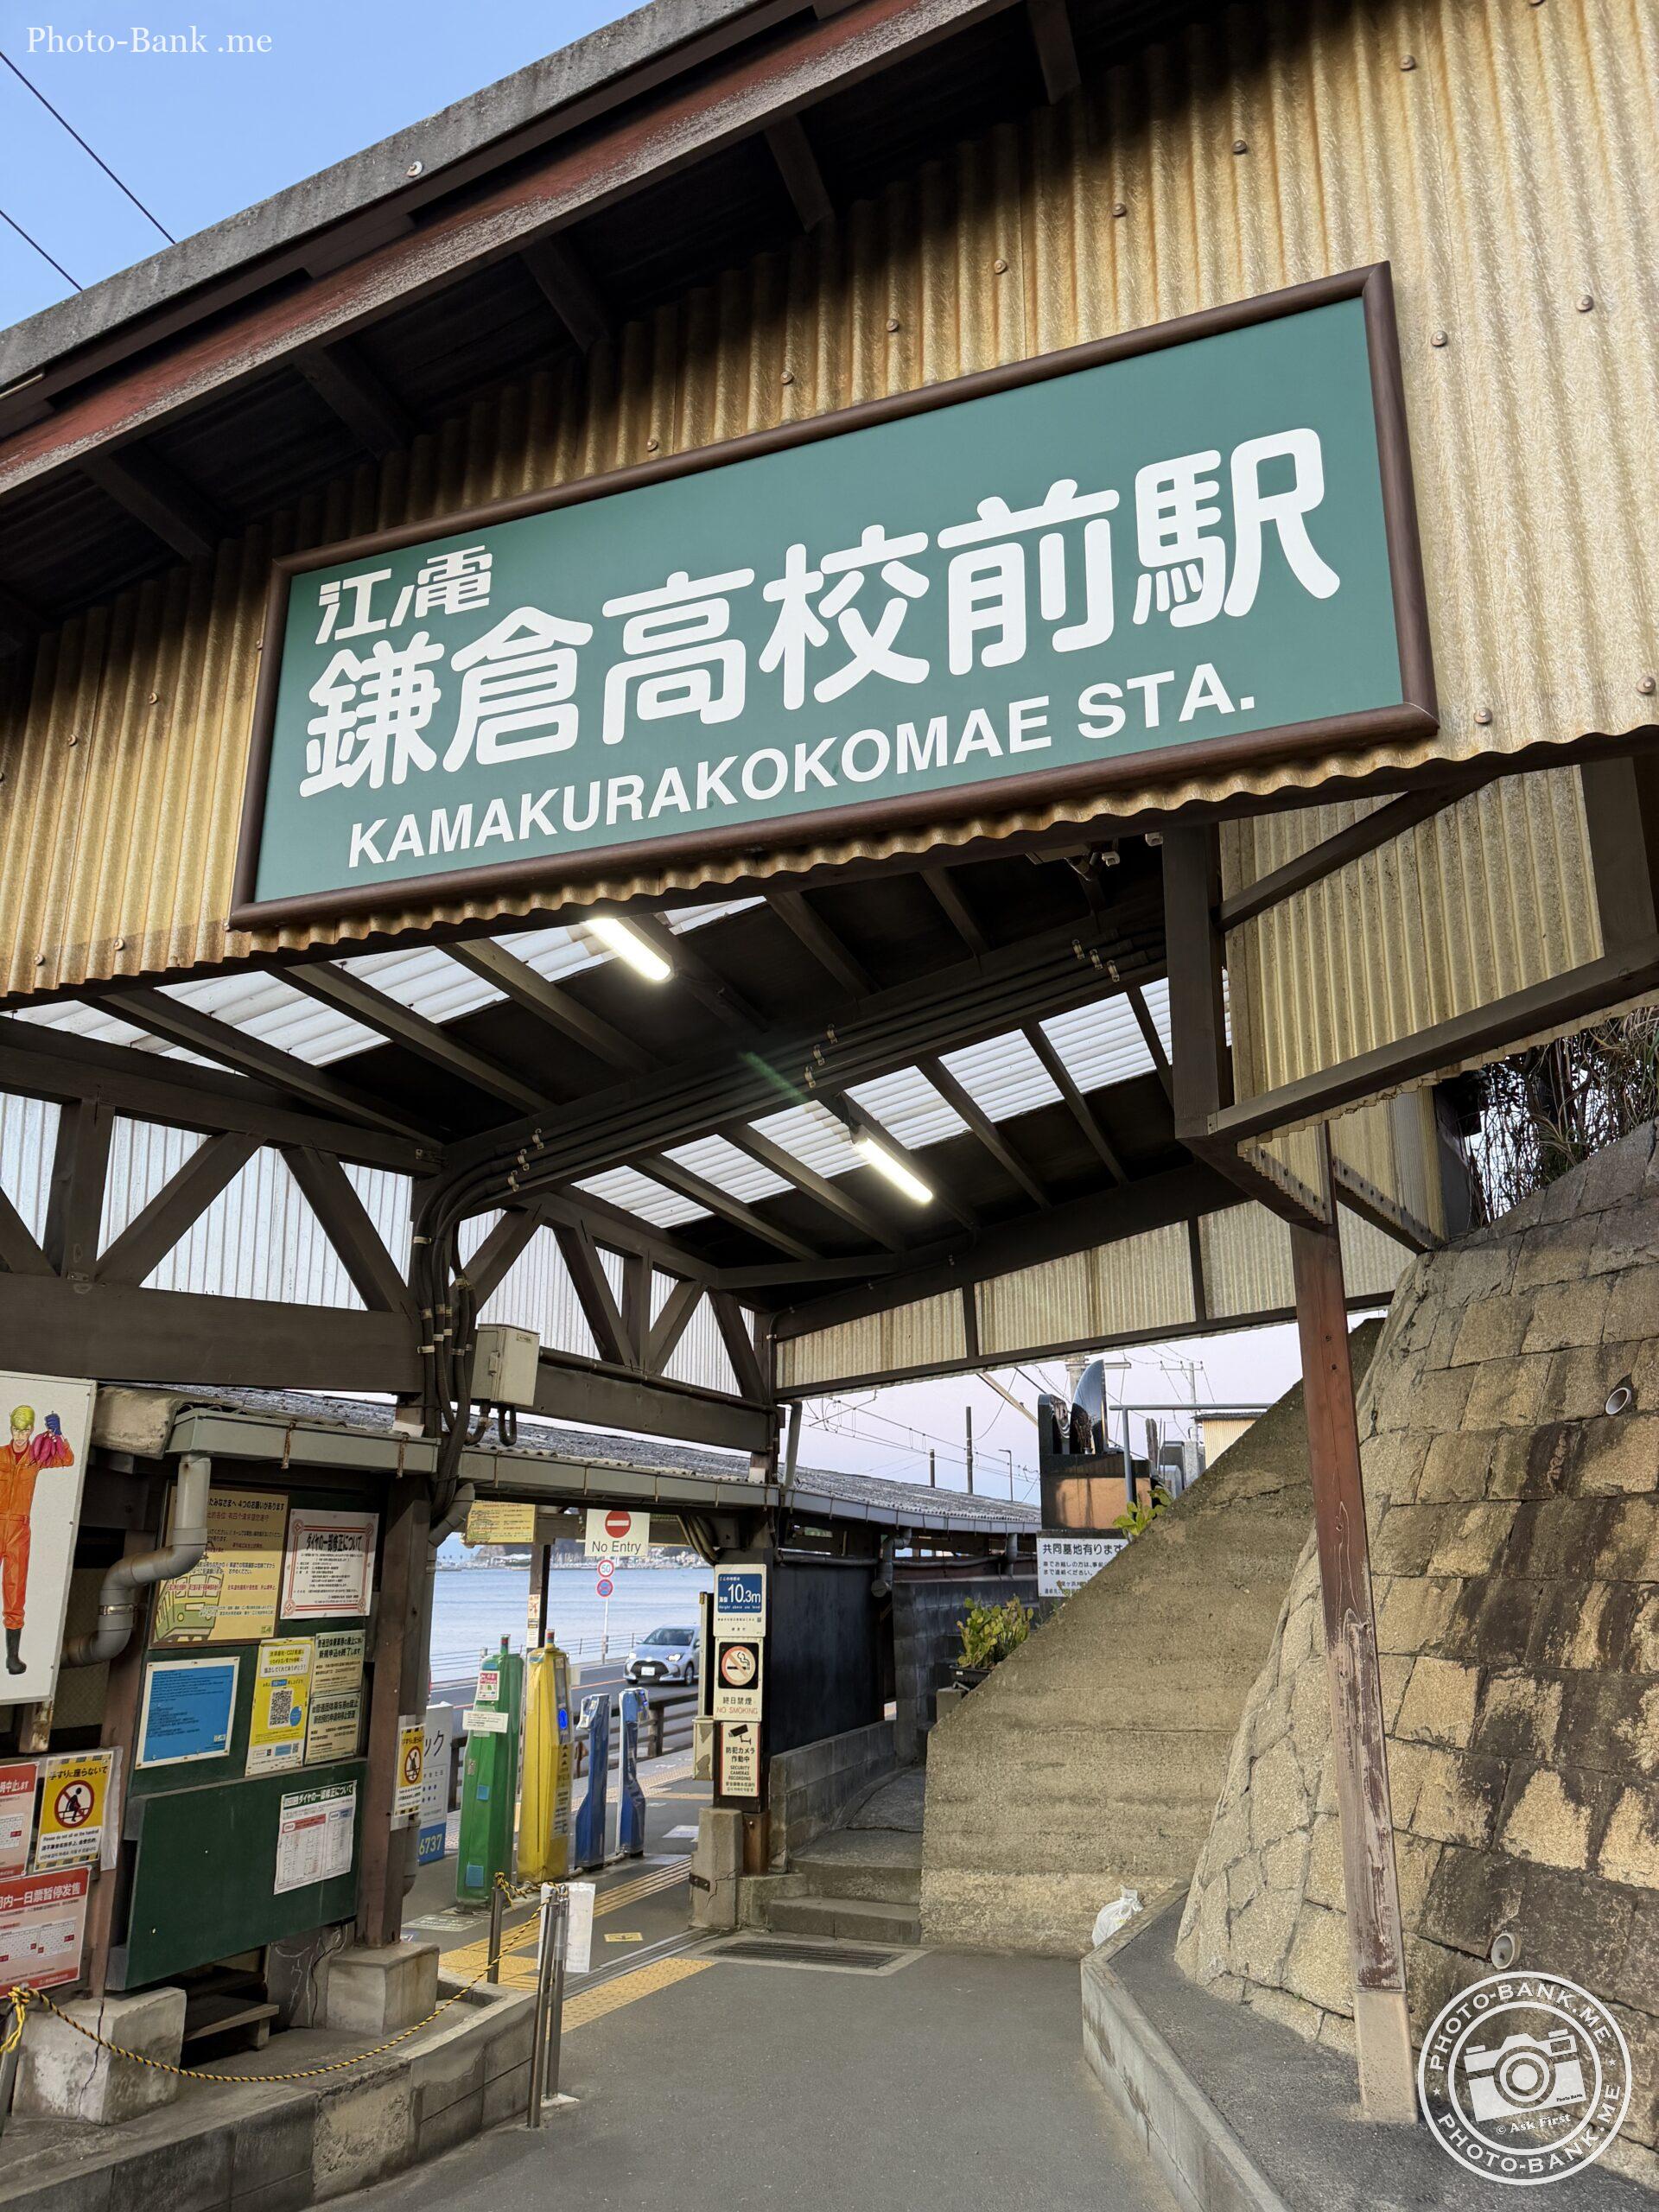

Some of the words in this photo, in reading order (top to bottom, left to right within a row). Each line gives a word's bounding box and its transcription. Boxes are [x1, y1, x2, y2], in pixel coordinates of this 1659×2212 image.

[315, 544, 493, 645] 江ノ電
[299, 428, 1341, 798] 鎌倉高校前駅
[348, 696, 1052, 868] KAMAKURAKOKOMAE
[1077, 663, 1255, 739] STA.
[592, 1541, 608, 1553] No
[612, 1541, 642, 1555] Entry
[728, 1583, 761, 1604] 10.3m
[722, 1696, 753, 1705] 終日禁煙
[48, 1765, 109, 1781] 手すりに座らないで
[418, 1833, 443, 1856] 6737
